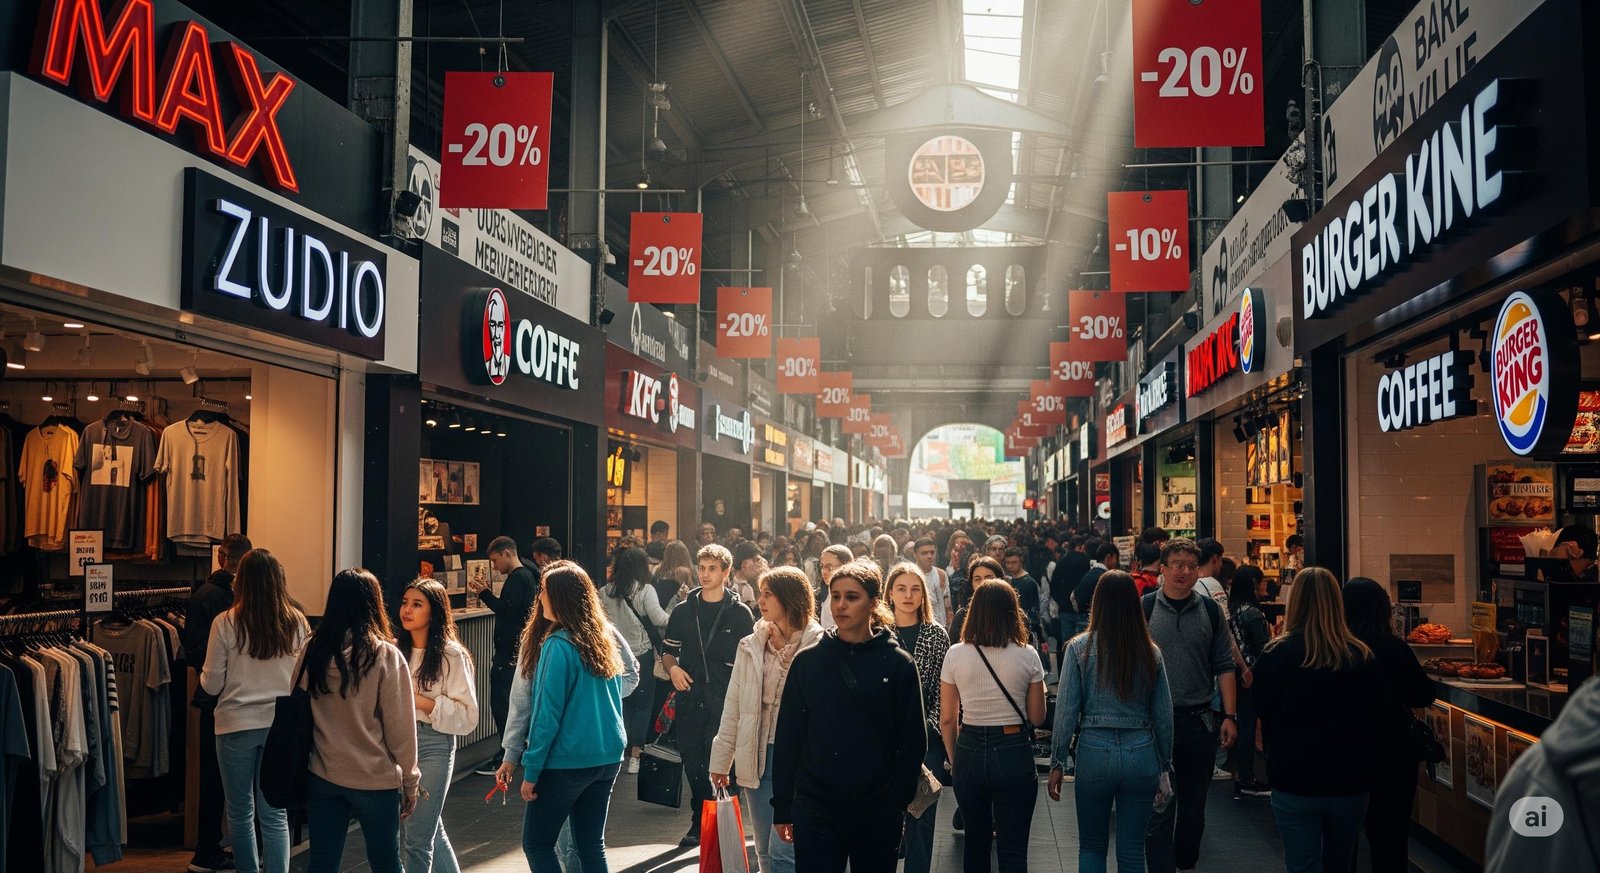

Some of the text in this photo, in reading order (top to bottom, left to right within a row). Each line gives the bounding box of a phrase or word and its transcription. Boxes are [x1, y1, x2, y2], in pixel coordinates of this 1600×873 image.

[41, 0, 299, 193] MAX
[1141, 46, 1254, 98] -20%
[448, 122, 541, 167] -20%
[1303, 173, 1401, 320] BURGER
[1406, 78, 1503, 254] KINE
[214, 199, 385, 339] ZUDIO
[633, 246, 696, 276] -20%
[1115, 228, 1182, 261] -10%
[719, 313, 768, 337] -20%
[1071, 315, 1123, 340] -30%
[1496, 318, 1539, 379] BURGER
[515, 319, 580, 390] COFFE
[1053, 361, 1093, 380] -30%
[629, 370, 662, 424] KFC
[816, 387, 850, 404] -20%
[1031, 395, 1064, 412] -30%
[1377, 350, 1456, 433] COFFEE
[1498, 346, 1543, 419] KING
